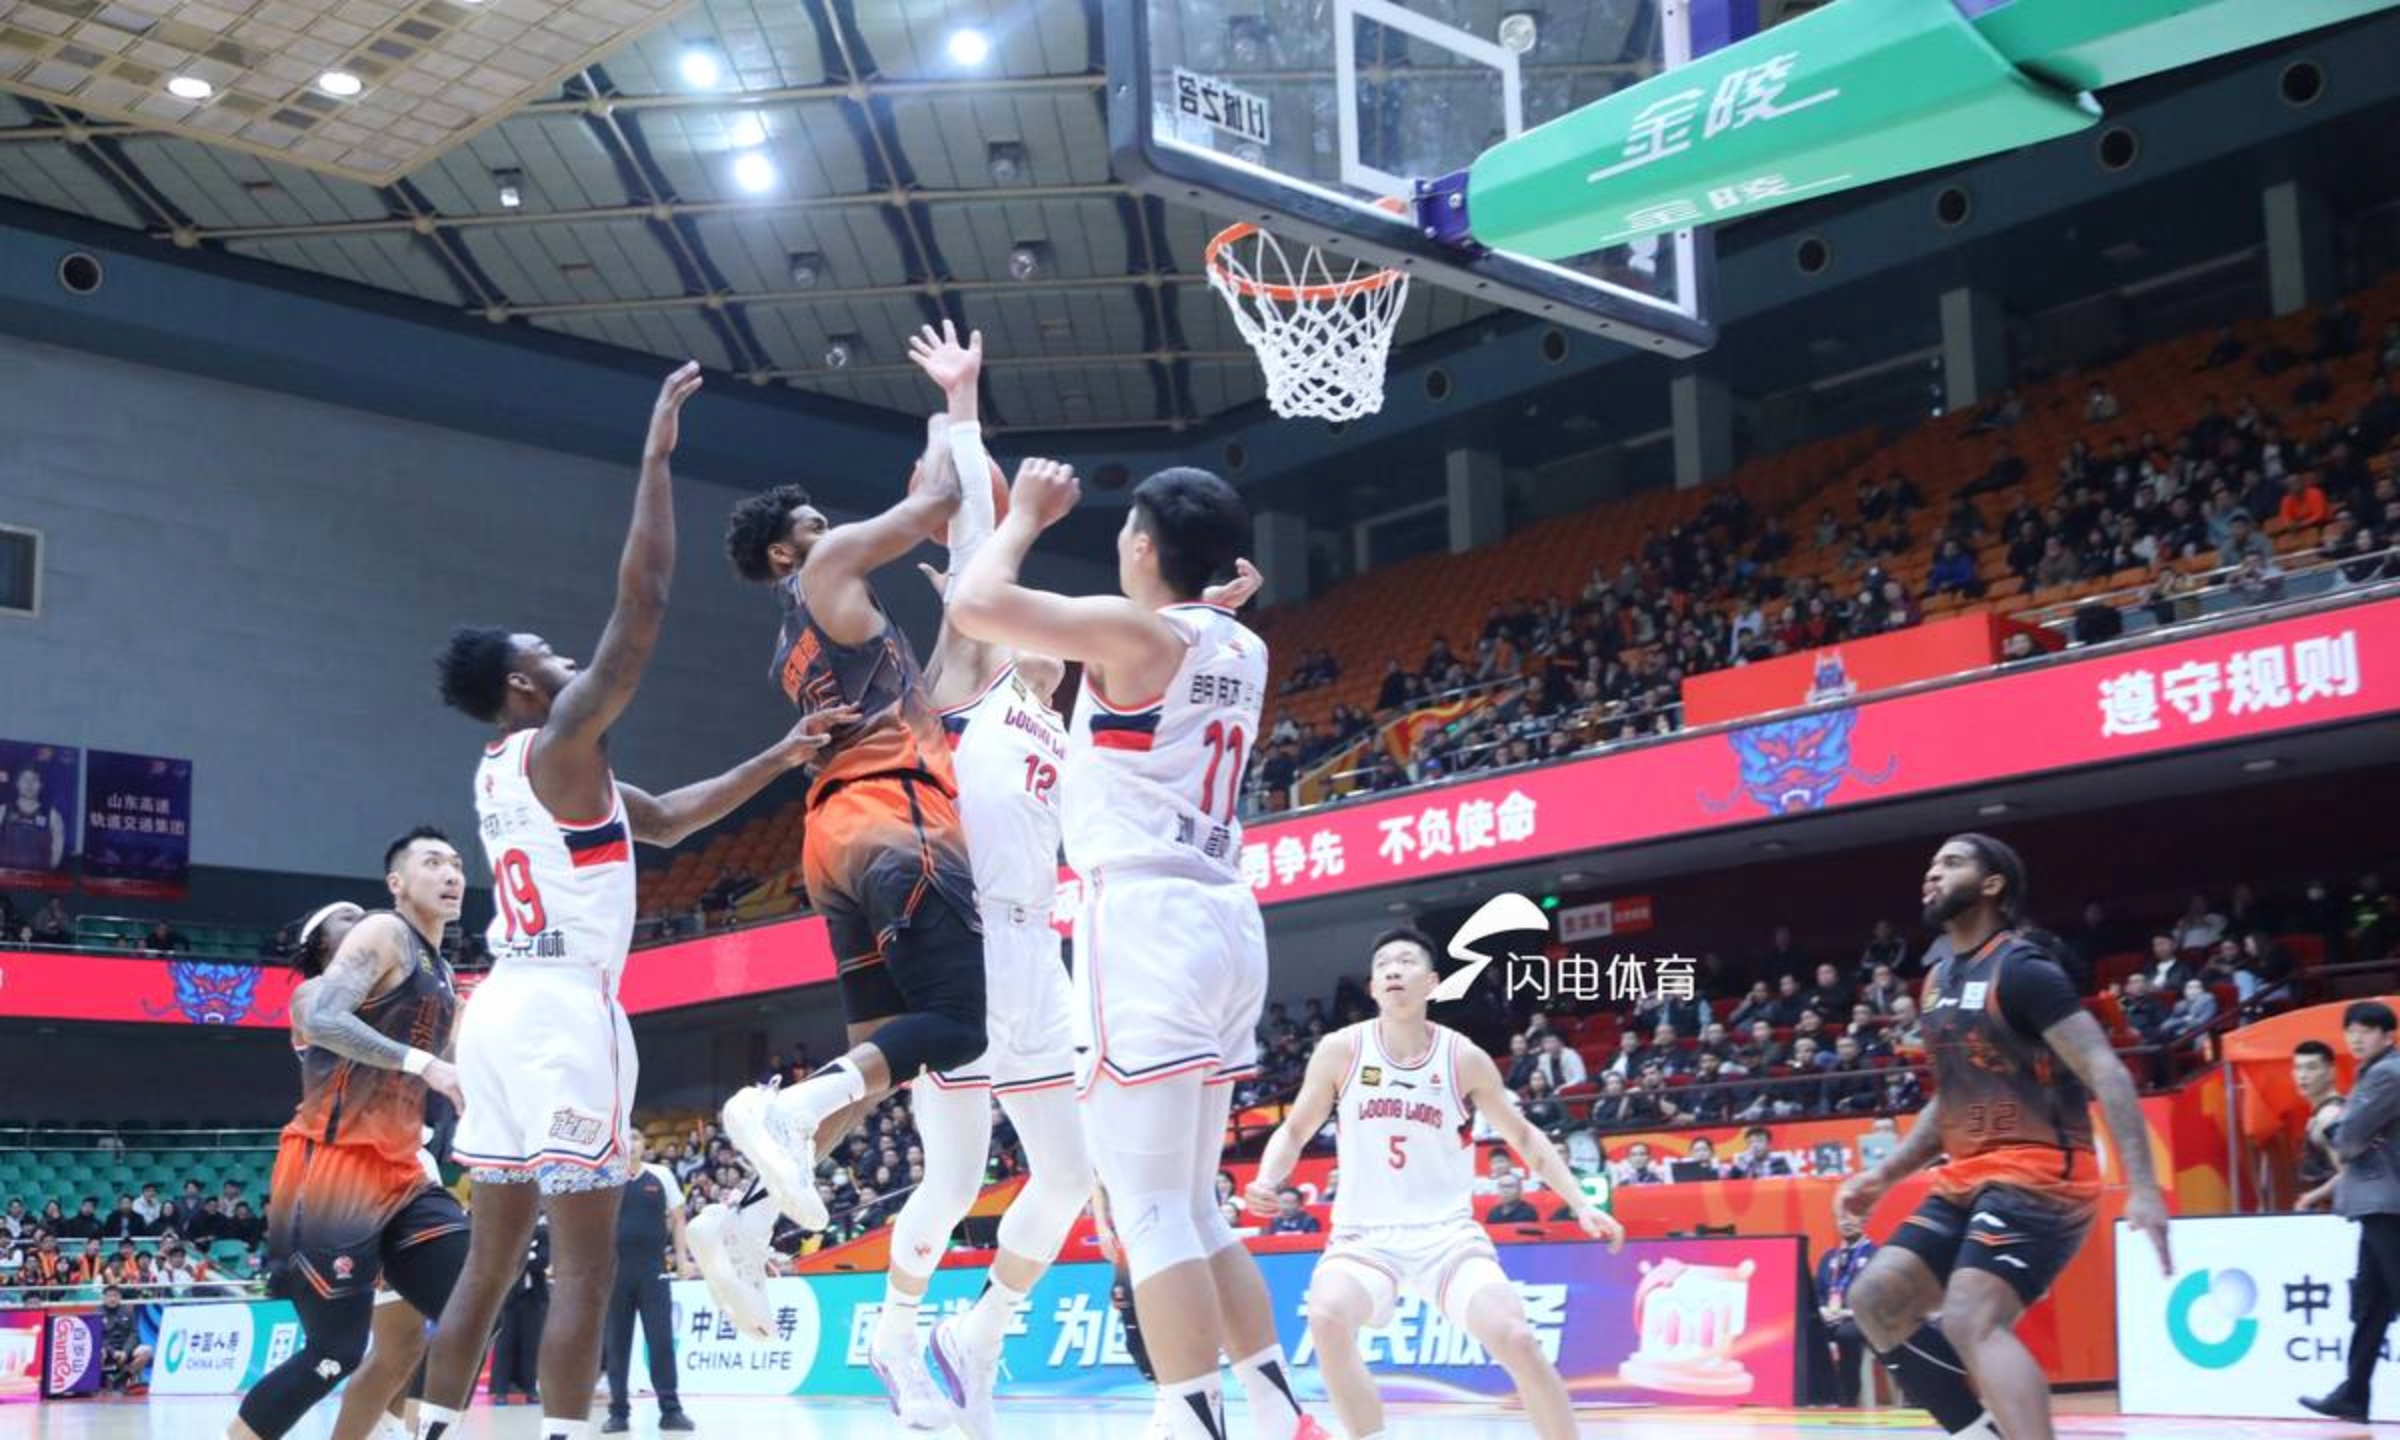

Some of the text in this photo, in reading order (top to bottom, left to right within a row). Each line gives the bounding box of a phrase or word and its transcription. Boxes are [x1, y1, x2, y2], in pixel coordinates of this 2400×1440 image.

[1587, 51, 1840, 183] 金陵
[2097, 629, 2361, 738] 遵守规则
[1025, 754, 1058, 806] 12
[1203, 719, 1244, 827] 11
[1377, 790, 1537, 866] 不负使命
[495, 847, 547, 942] 19
[1388, 1135, 1407, 1169] 5
[686, 1350, 792, 1372] CHINA LIFE
[691, 1306, 798, 1343] 中国寿
